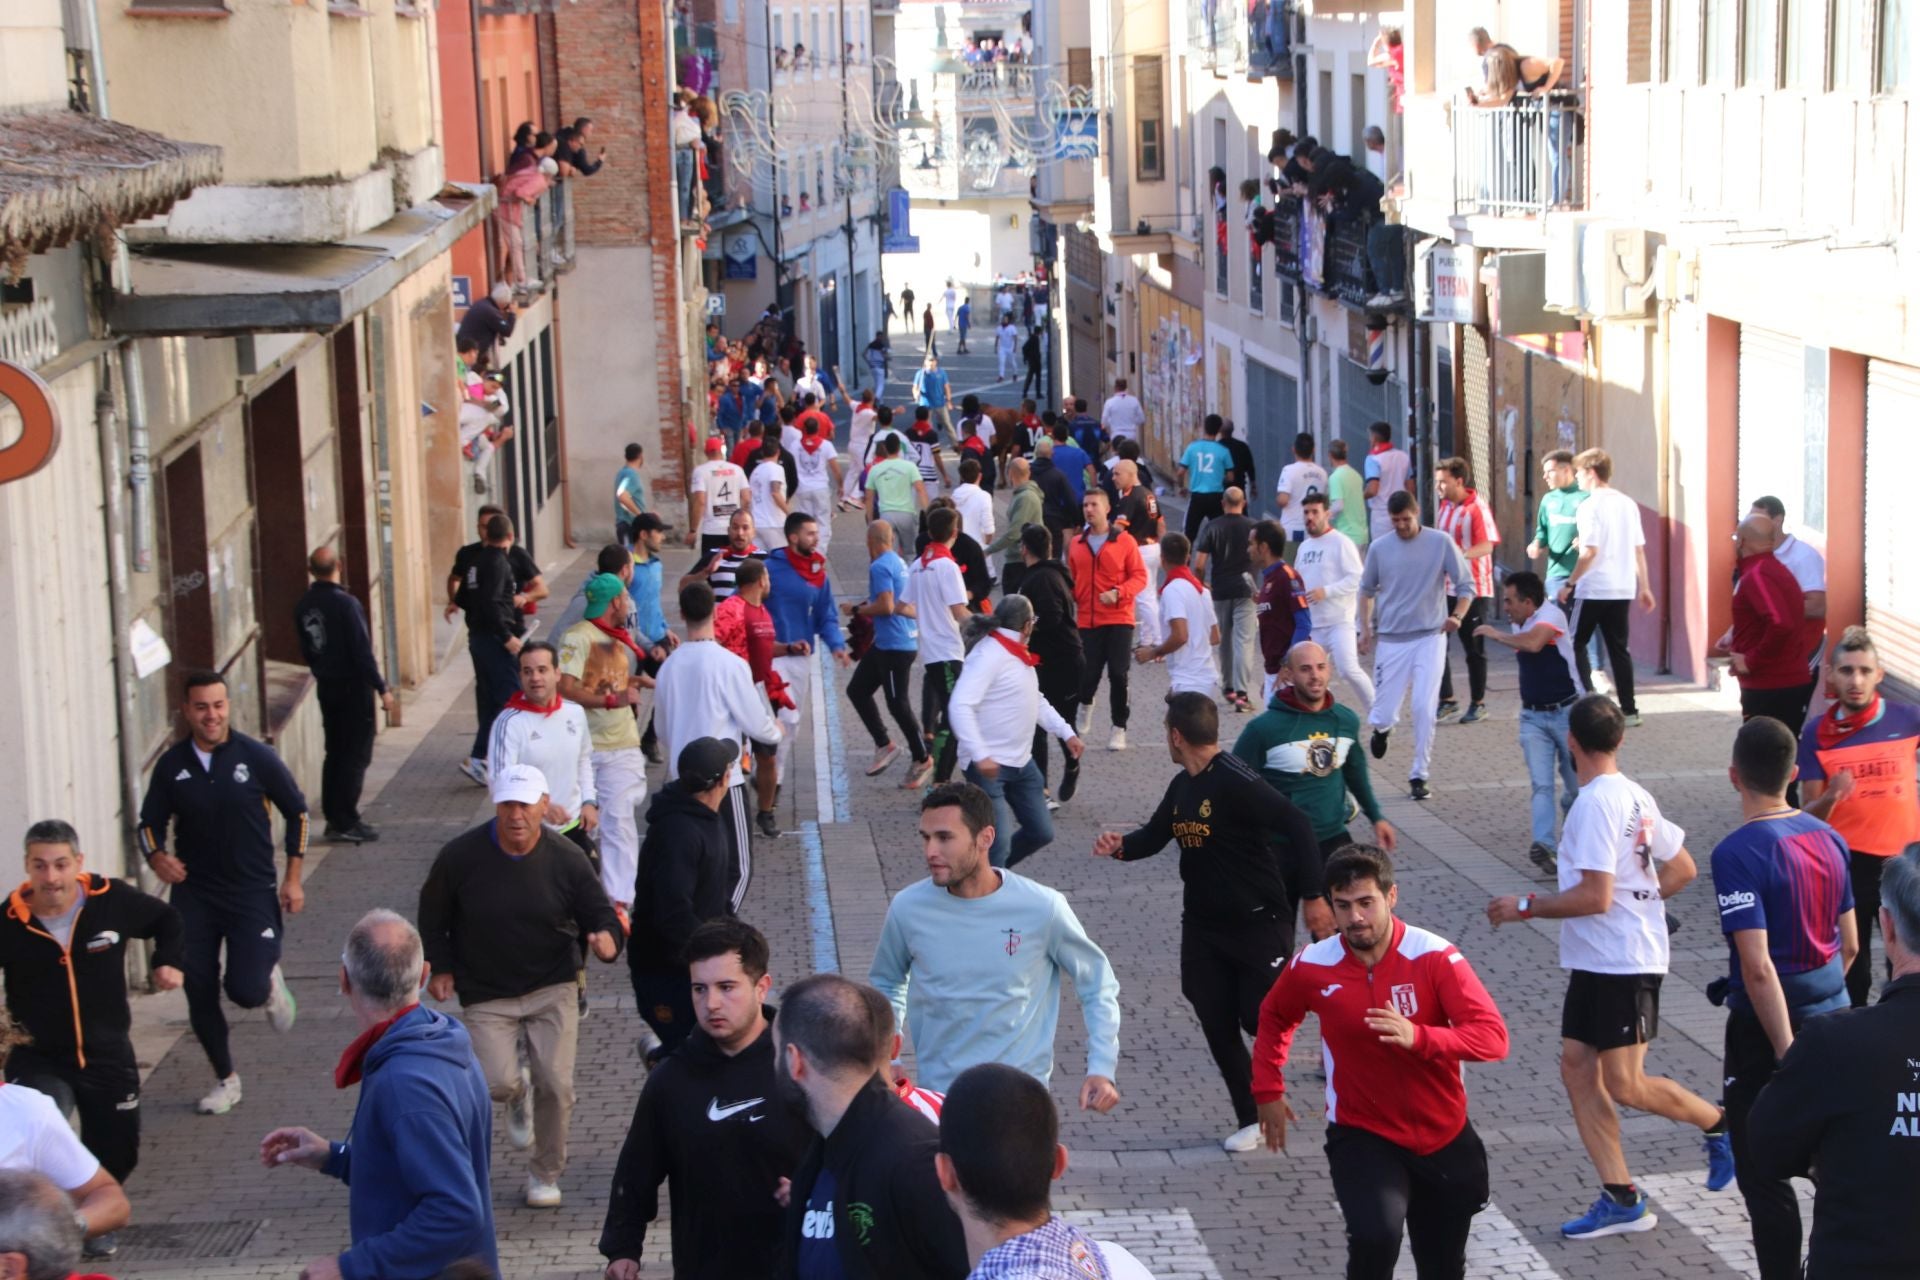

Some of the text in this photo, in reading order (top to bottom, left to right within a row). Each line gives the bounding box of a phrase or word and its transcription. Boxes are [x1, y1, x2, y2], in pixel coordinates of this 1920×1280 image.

[708, 297, 721, 314] P
[1197, 452, 1215, 473] 12
[717, 481, 732, 502] 4
[1172, 820, 1211, 837] Emirates
[1718, 890, 1755, 907] beko
